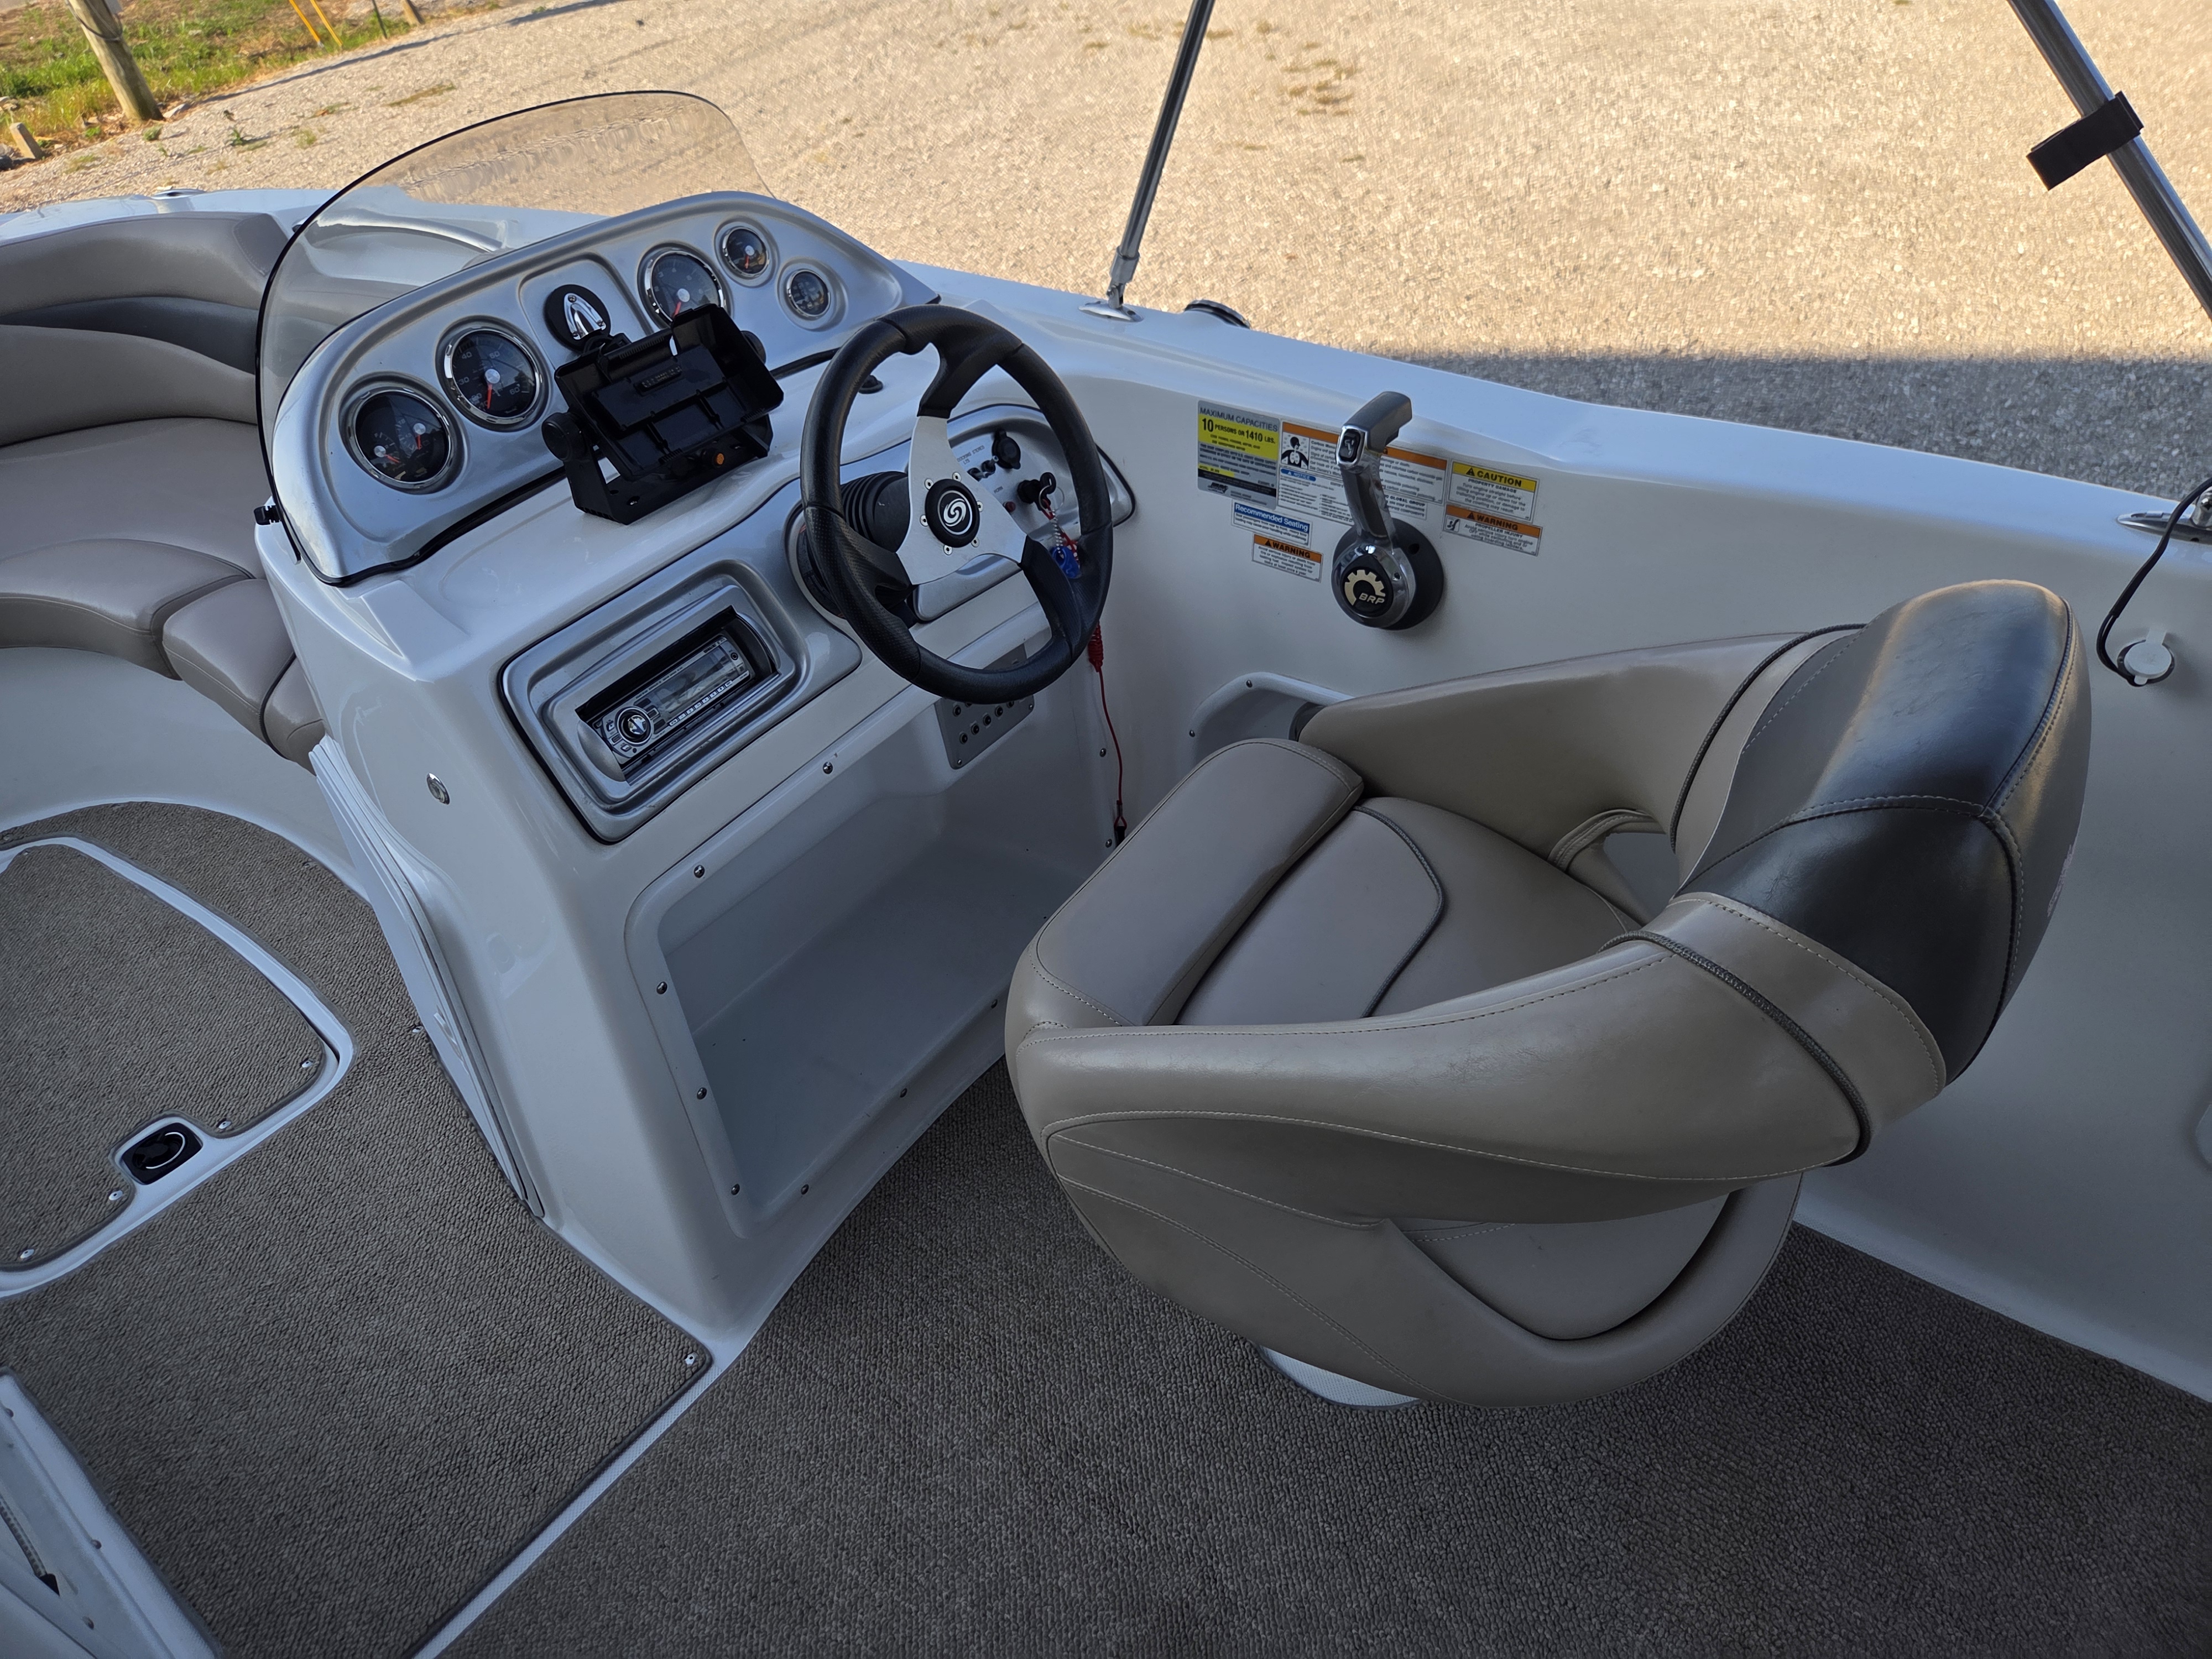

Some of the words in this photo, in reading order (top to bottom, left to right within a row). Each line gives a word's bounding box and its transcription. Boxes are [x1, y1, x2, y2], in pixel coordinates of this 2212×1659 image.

[461, 351, 472, 360] 40
[458, 377, 470, 385] 30
[509, 386, 521, 395] 60
[1199, 407, 1234, 421] MAXIMUM
[1235, 416, 1278, 432] CAPACITIES
[1202, 418, 1214, 432] 10
[1214, 424, 1237, 435] PERSONS
[1245, 430, 1263, 442] 1410
[972, 445, 985, 455] STEREO
[957, 452, 972, 462] DOCKING
[1293, 472, 1310, 481] NOTICE
[1477, 470, 1522, 487] CAUTION
[1468, 478, 1494, 488] PROPERTY
[1235, 504, 1282, 523] Recommended
[1284, 518, 1308, 532] Seating
[1477, 514, 1518, 531] WARNING
[1272, 541, 1311, 559] WARNING
[1359, 592, 1385, 604] BRP
